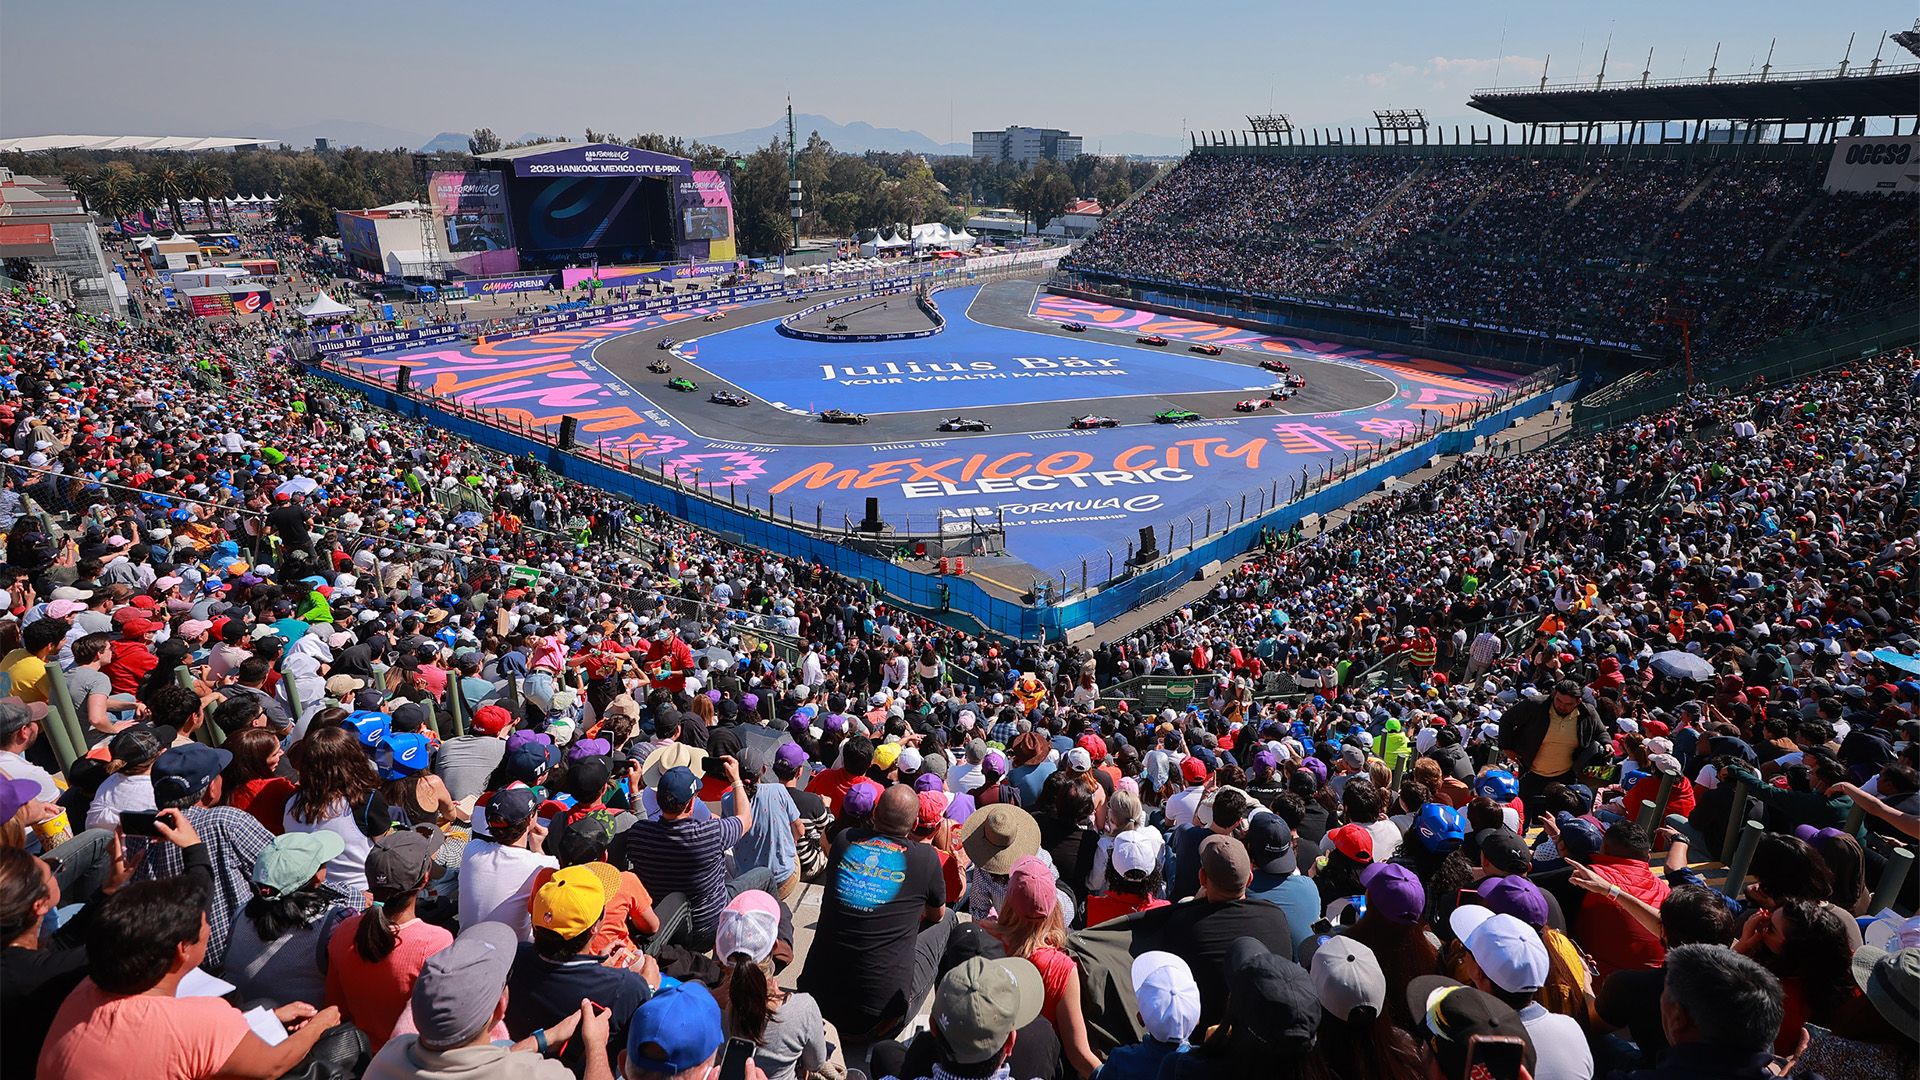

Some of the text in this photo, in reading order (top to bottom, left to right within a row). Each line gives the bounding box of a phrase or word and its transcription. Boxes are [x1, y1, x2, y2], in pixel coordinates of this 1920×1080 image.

[1845, 143, 1912, 165] ocesa
[530, 165, 681, 173] 2023 HANKOOK MEXICO CITY E-PRIX
[453, 184, 489, 194] FORMULA
[700, 266, 725, 274] ARENA
[482, 279, 545, 294] GAMING ARENA
[735, 288, 748, 296] Julius
[677, 296, 692, 304] Julius
[706, 292, 721, 300] Julius
[612, 306, 628, 315] Julius
[645, 301, 661, 310] Julius
[537, 316, 556, 326] Julius
[576, 312, 594, 320] Julius
[418, 325, 455, 338] Julius Bär
[370, 332, 410, 345] Julius Bär
[318, 339, 361, 353] Julius Bär
[819, 356, 1121, 381] Julius Bär
[839, 369, 1129, 387] YOUR WEALTH MANAGER
[1029, 429, 1101, 441] Julius Bär
[704, 442, 748, 450] Julius
[872, 440, 948, 452] Julius Bär
[769, 437, 1269, 494] MEXICO CITY
[901, 467, 1194, 499] ELECTRIC
[938, 506, 994, 519] ABB
[997, 498, 1122, 522] FORMULA
[1030, 513, 1128, 525] CHAMPIONSHIP
